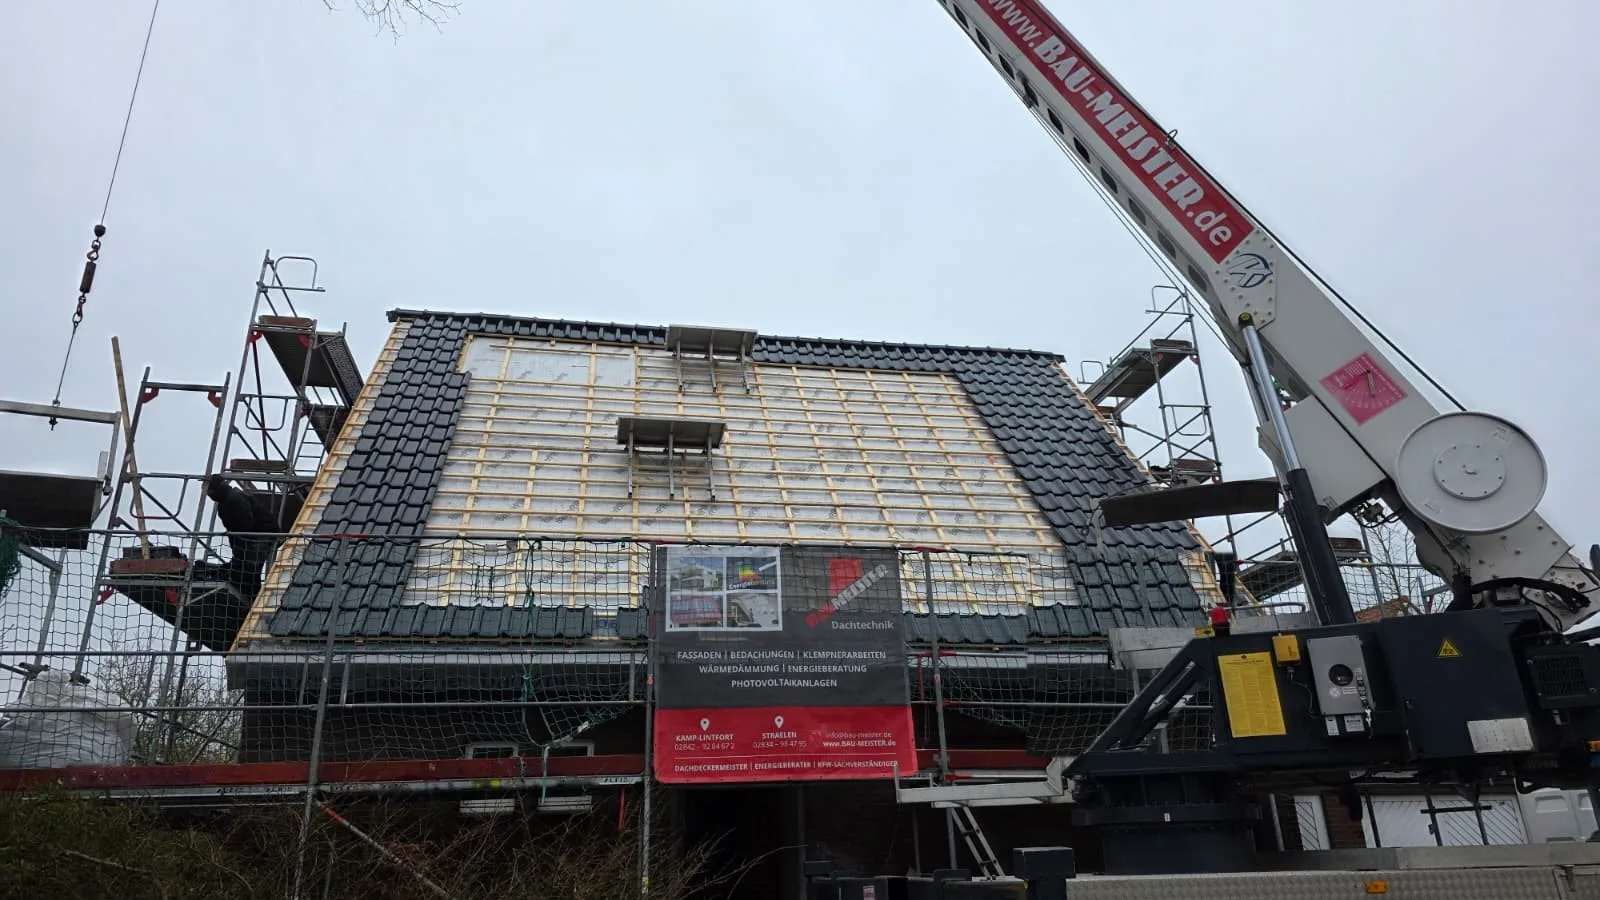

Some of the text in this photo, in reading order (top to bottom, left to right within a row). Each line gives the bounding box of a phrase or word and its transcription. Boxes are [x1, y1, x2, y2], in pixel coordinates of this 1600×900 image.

[830, 563, 889, 611] MEISTER
[831, 620, 894, 630] Dachtechnik
[677, 650, 887, 659] FASSADEN BEDACHUNGEN KLEMPNERARBEITEN
[699, 663, 868, 673] WÄRMEDÄMMUNG ENERGIEBERATUNG
[731, 678, 838, 688] PHOTOVOLTAIKANLAGEN
[675, 734, 734, 742] KAMP-LINTFORT
[761, 731, 797, 739] STRAELEN
[822, 739, 897, 748] www.BAU-MEISTER.de
[674, 763, 749, 772] DACHDECKERMEISTER
[754, 761, 812, 770] ENERGIEBERATER
